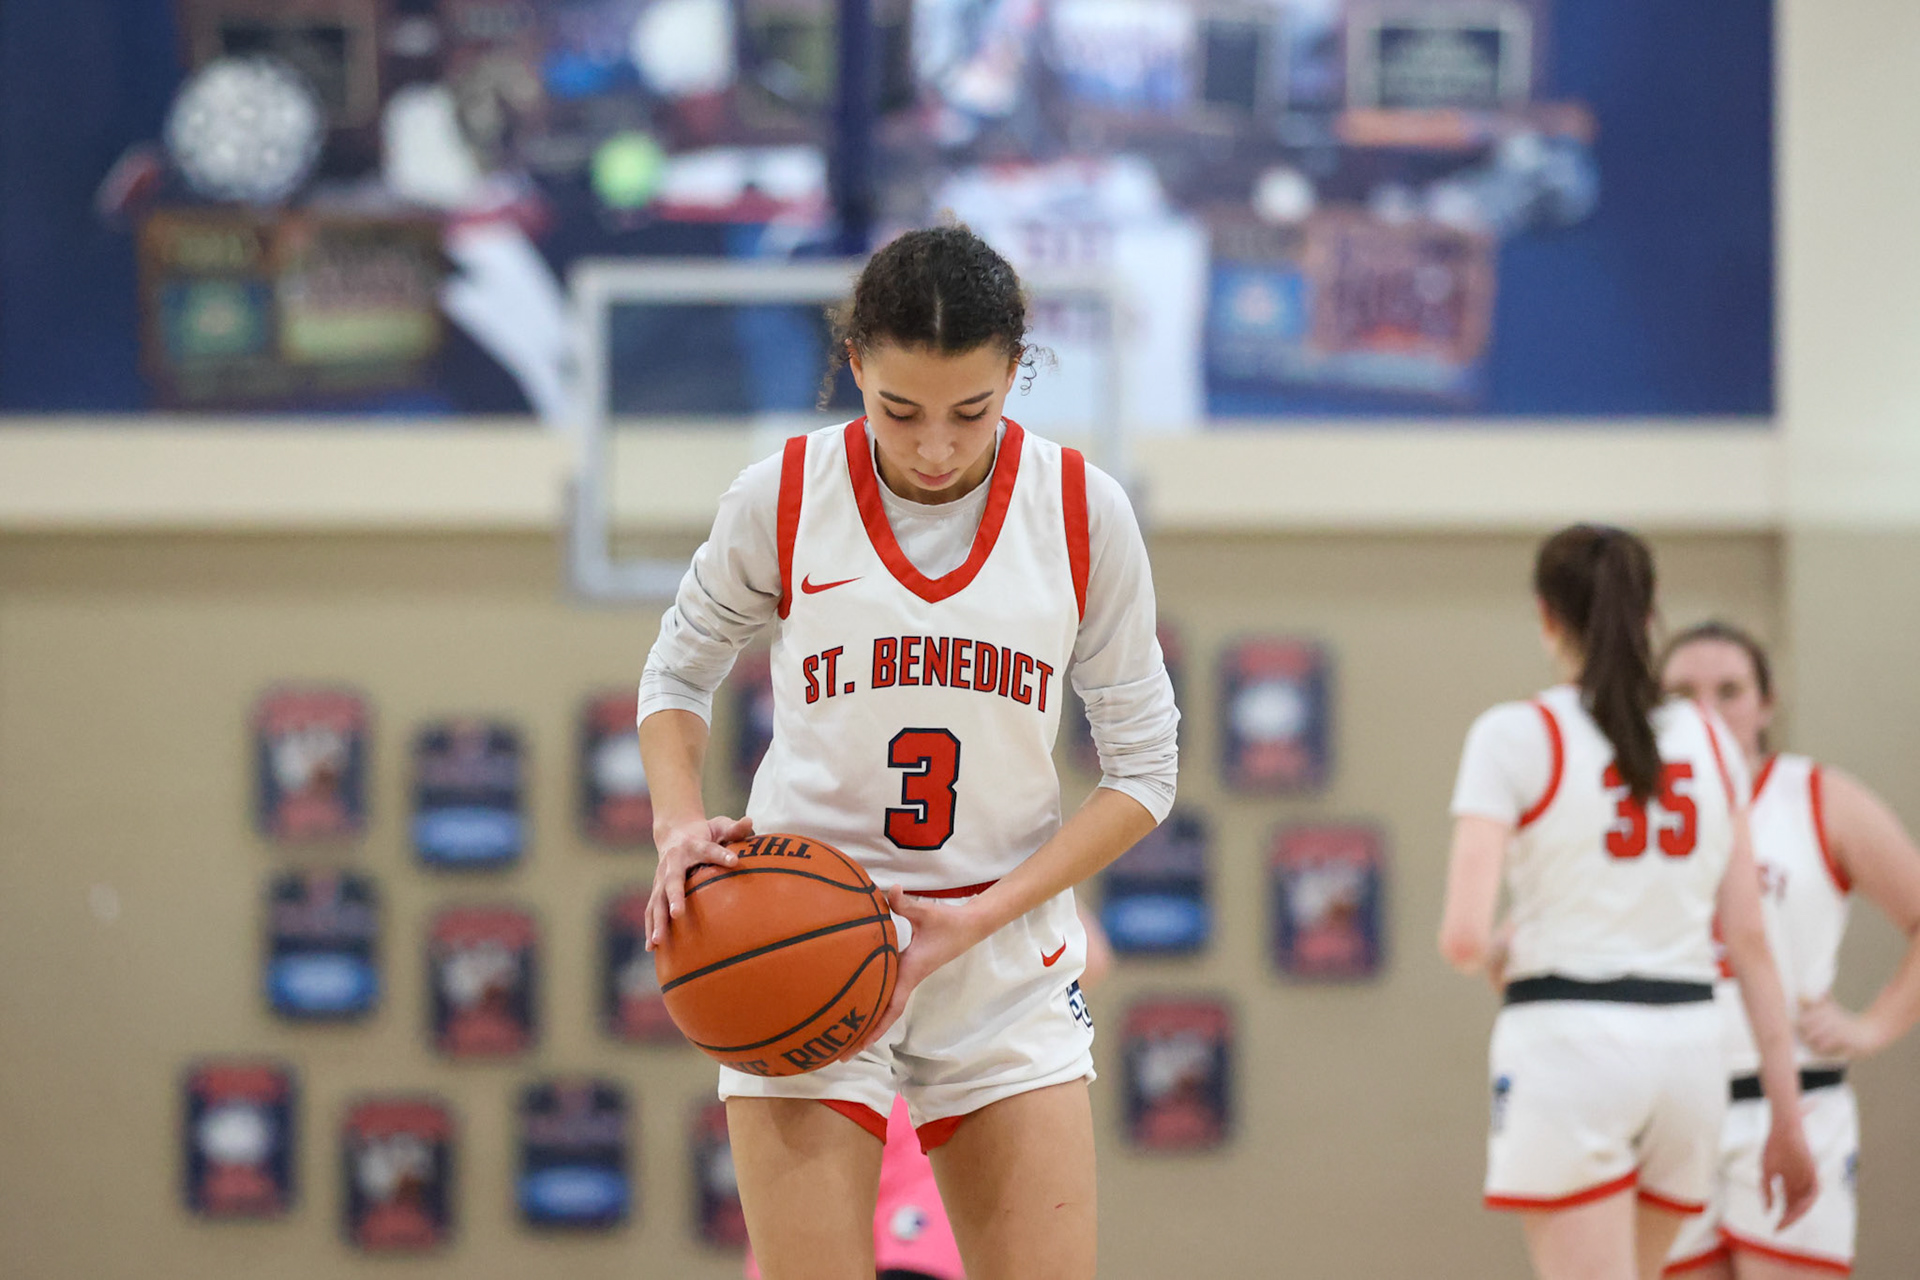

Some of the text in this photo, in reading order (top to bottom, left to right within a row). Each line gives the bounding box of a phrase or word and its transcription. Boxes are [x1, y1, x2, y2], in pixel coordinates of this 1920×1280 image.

[802, 635, 1054, 713] ST. BENEDICT
[884, 727, 961, 850] 3
[1602, 761, 1697, 858] 35
[737, 836, 811, 859] THE
[781, 1006, 867, 1070] ROCK
